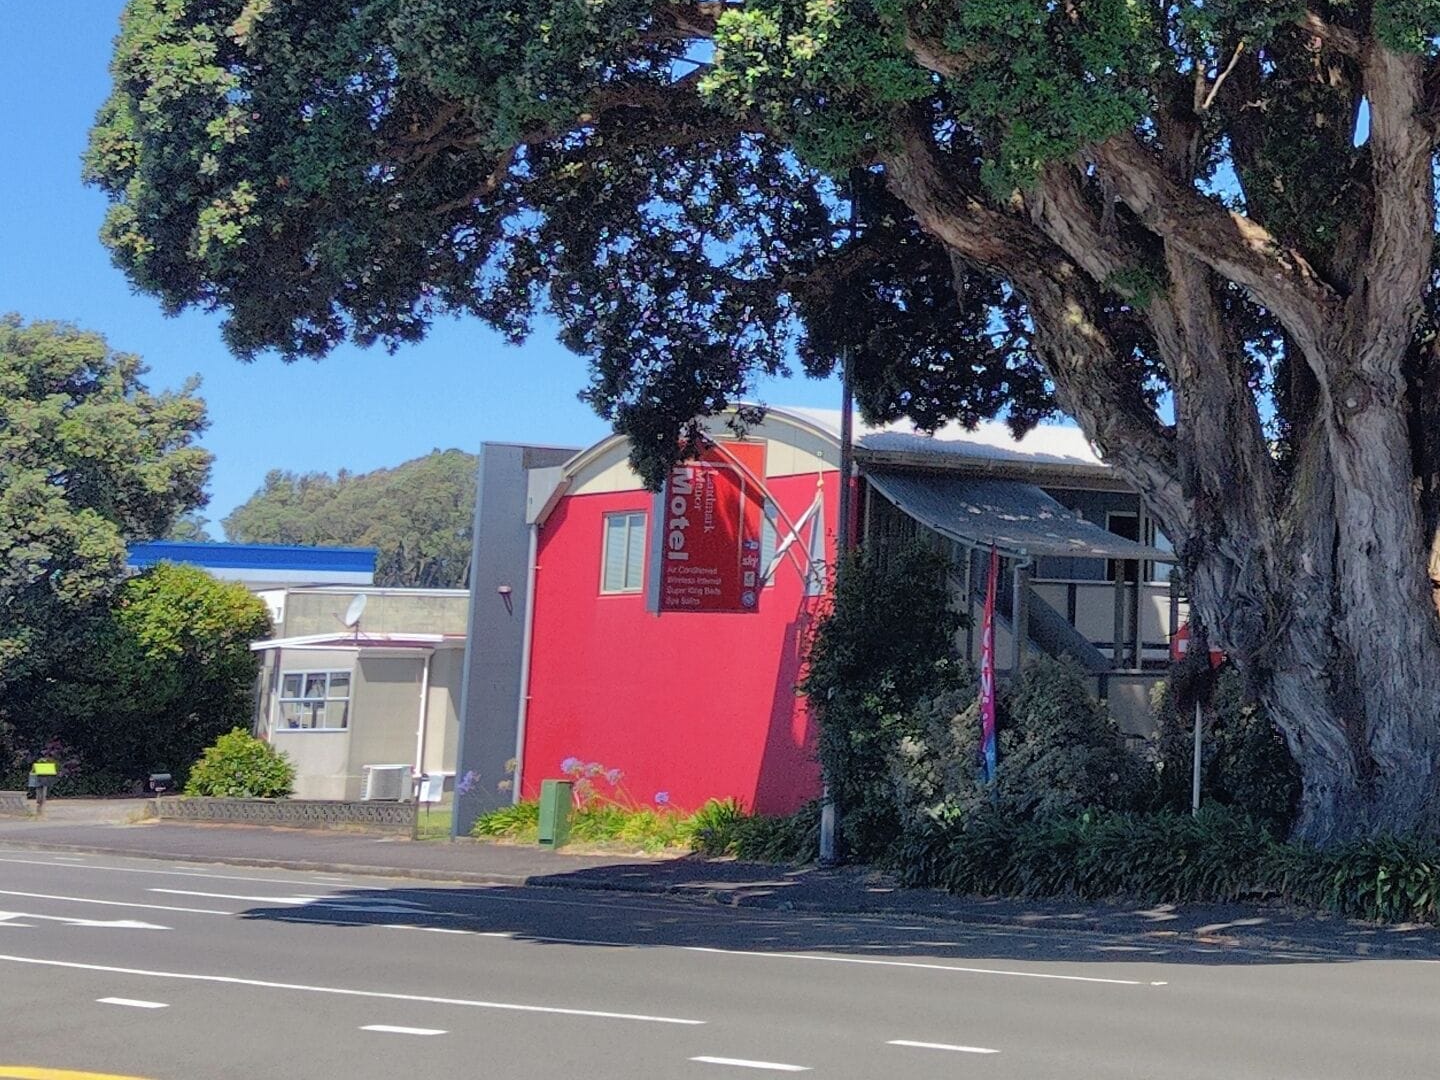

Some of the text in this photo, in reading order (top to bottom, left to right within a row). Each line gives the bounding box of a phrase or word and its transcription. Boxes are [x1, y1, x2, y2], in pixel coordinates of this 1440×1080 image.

[668, 467, 694, 560] Motel
[694, 469, 706, 510] Manor
[704, 470, 719, 533] Landmark
[742, 555, 758, 568] sky
